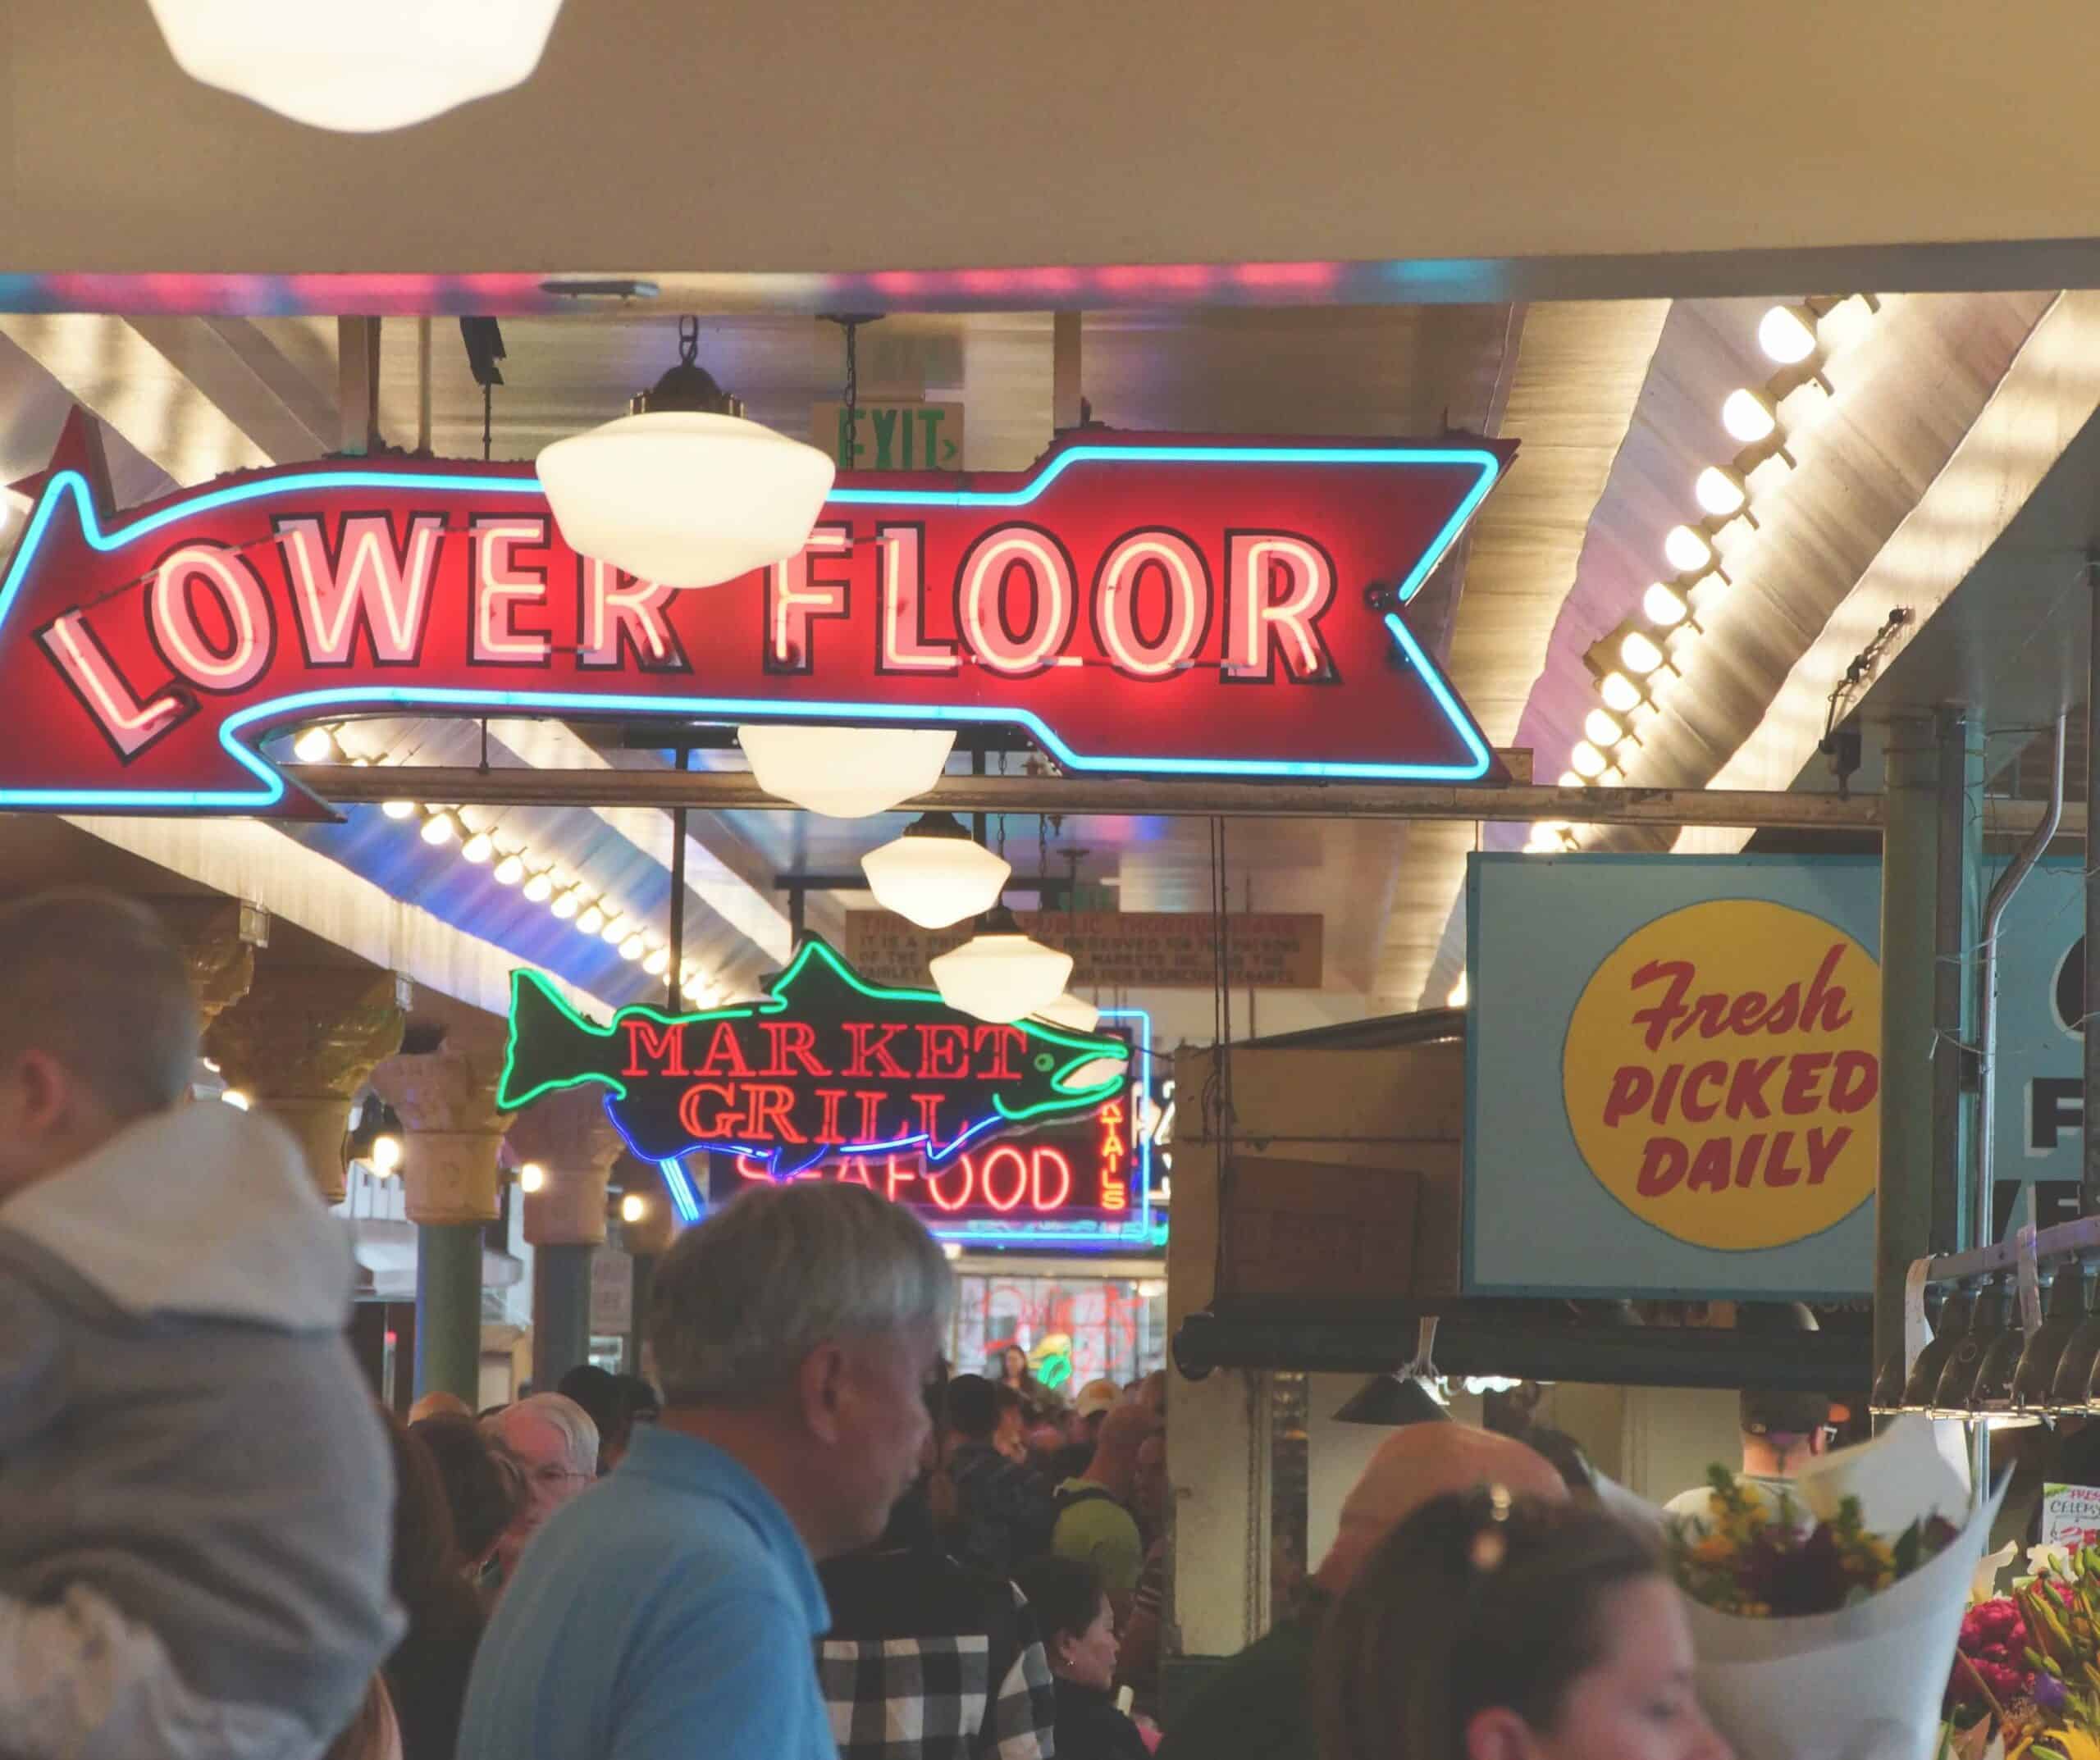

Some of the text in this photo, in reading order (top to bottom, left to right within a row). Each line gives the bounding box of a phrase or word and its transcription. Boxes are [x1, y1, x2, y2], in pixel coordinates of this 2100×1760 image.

[836, 407, 945, 469] EXIT
[31, 511, 1343, 766] LOWER FLOOR
[1630, 943, 1853, 1053] Fresh
[620, 1019, 1029, 1079] MARKET
[678, 1082, 970, 1148] GRILL
[1603, 1049, 1879, 1128] PICKED
[737, 1145, 1070, 1211] AFOOD
[1100, 1099, 1127, 1211] KTAILS
[1636, 1126, 1855, 1198] DAILY
